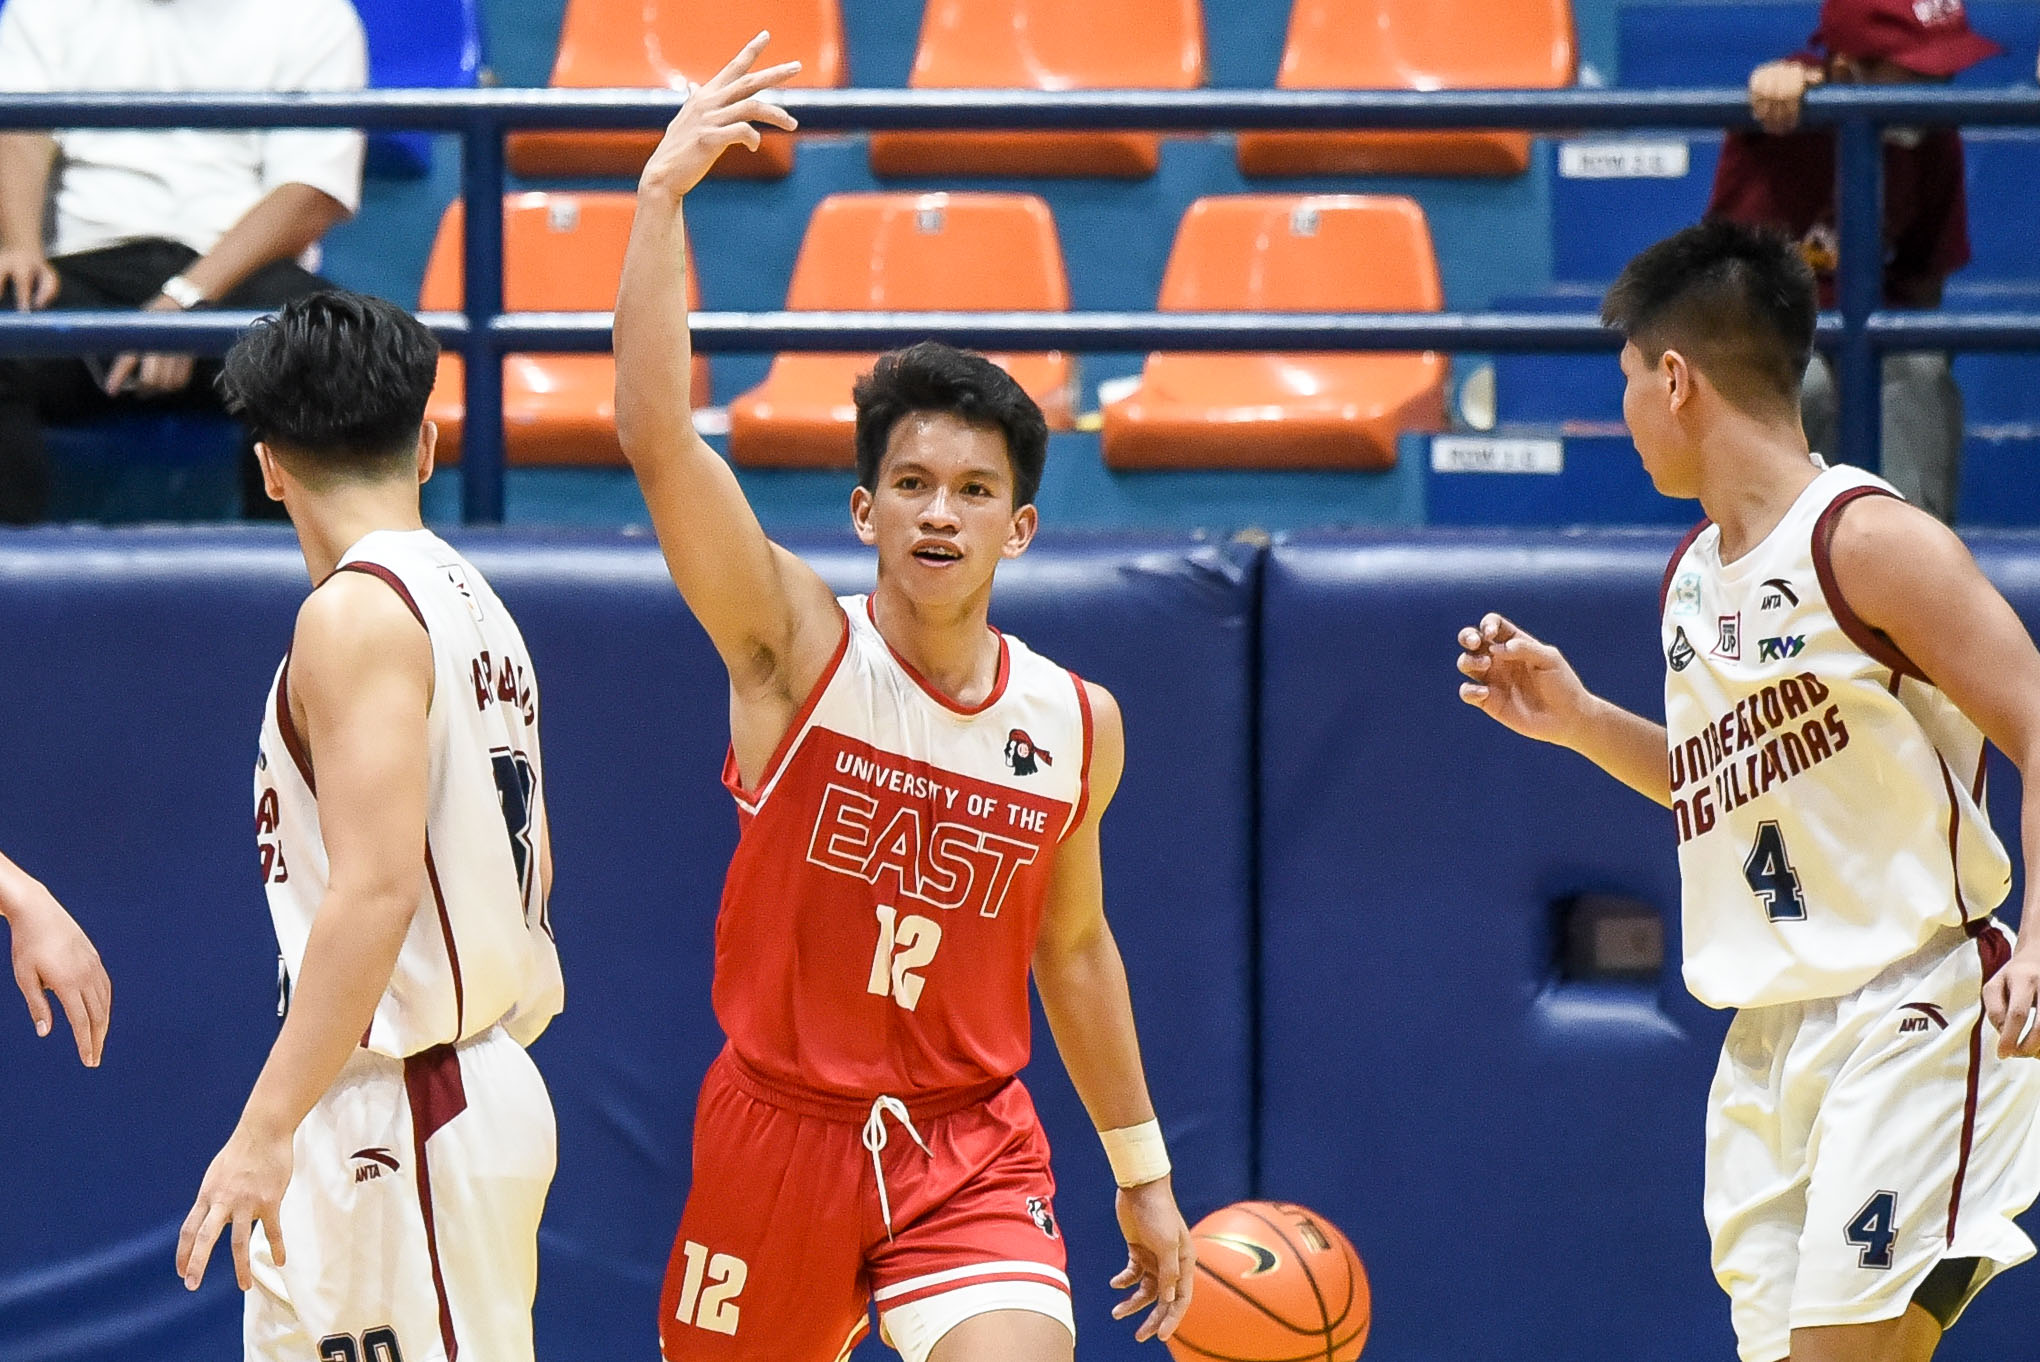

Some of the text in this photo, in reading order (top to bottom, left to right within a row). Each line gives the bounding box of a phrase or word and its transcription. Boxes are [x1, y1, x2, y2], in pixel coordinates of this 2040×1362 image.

[1760, 594, 1782, 610] ANTA
[834, 750, 1049, 834] UNIVERSITY OF THE
[805, 782, 1040, 919] EAST
[1742, 818, 1808, 923] 4
[867, 903, 943, 1012] 12
[1898, 1016, 1929, 1033] ANTA
[355, 1163, 382, 1184] ANTA
[1842, 1189, 1900, 1270] 4
[675, 1239, 748, 1337] 12
